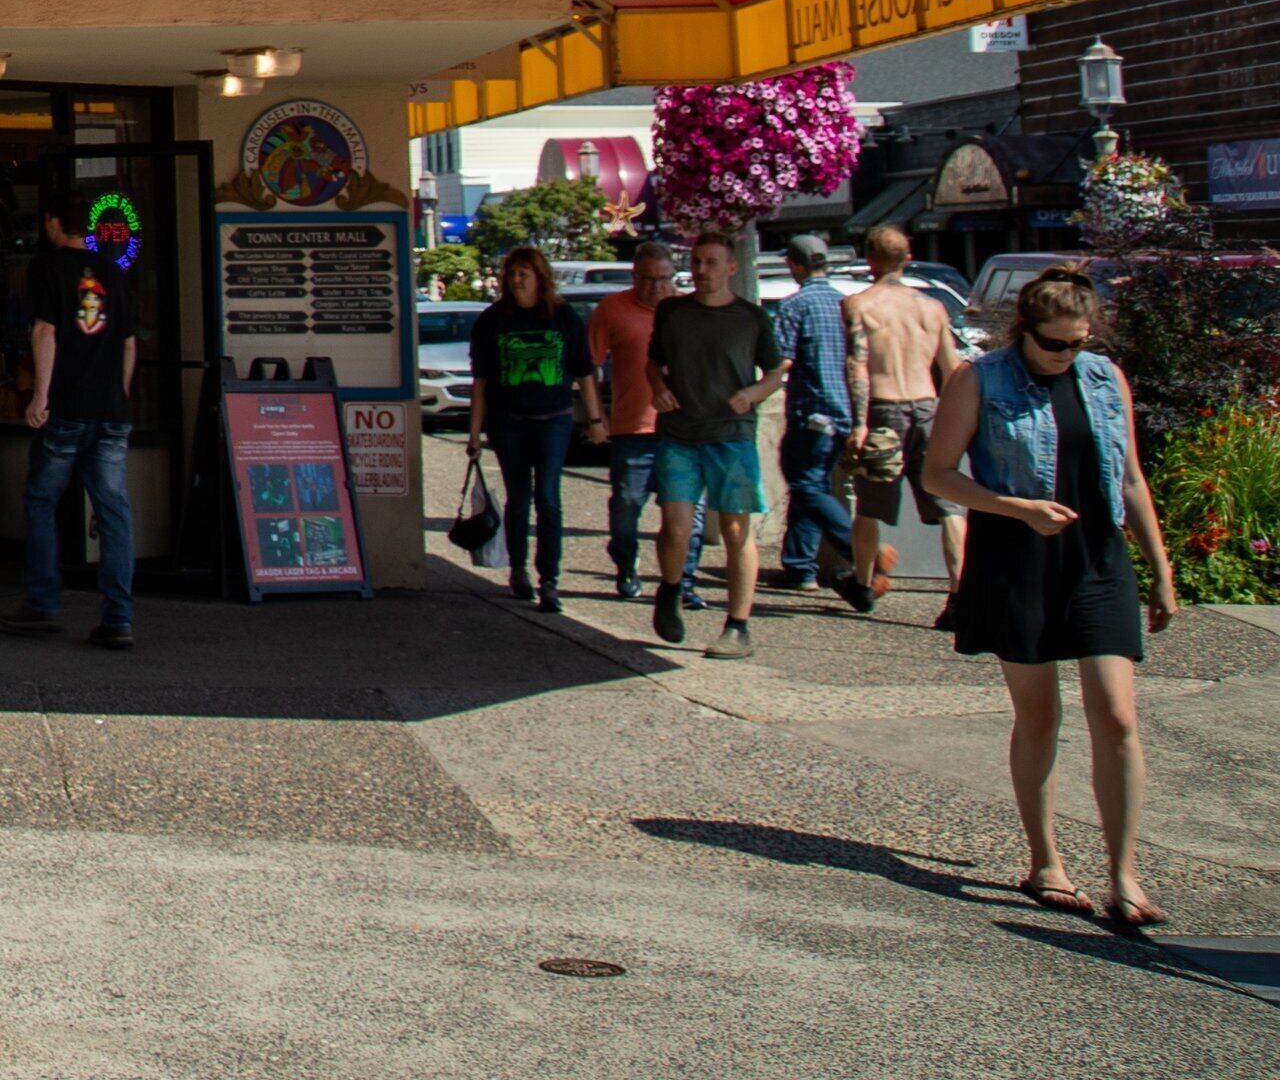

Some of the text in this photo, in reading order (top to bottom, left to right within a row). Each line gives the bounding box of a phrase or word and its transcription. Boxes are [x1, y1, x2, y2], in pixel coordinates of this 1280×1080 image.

[981, 31, 1021, 39] OREGON
[246, 103, 366, 165] CAROUSEL IN THE MALL
[87, 194, 140, 231] CHINESE FOOD
[96, 222, 130, 243] OPEN
[246, 231, 369, 244] TOWN CENTER MALL
[355, 409, 395, 430] NO
[379, 453, 402, 467] RIDING
[256, 568, 282, 577] SEASIDE
[306, 567, 320, 575] TAG
[328, 566, 358, 575] ARCADE
